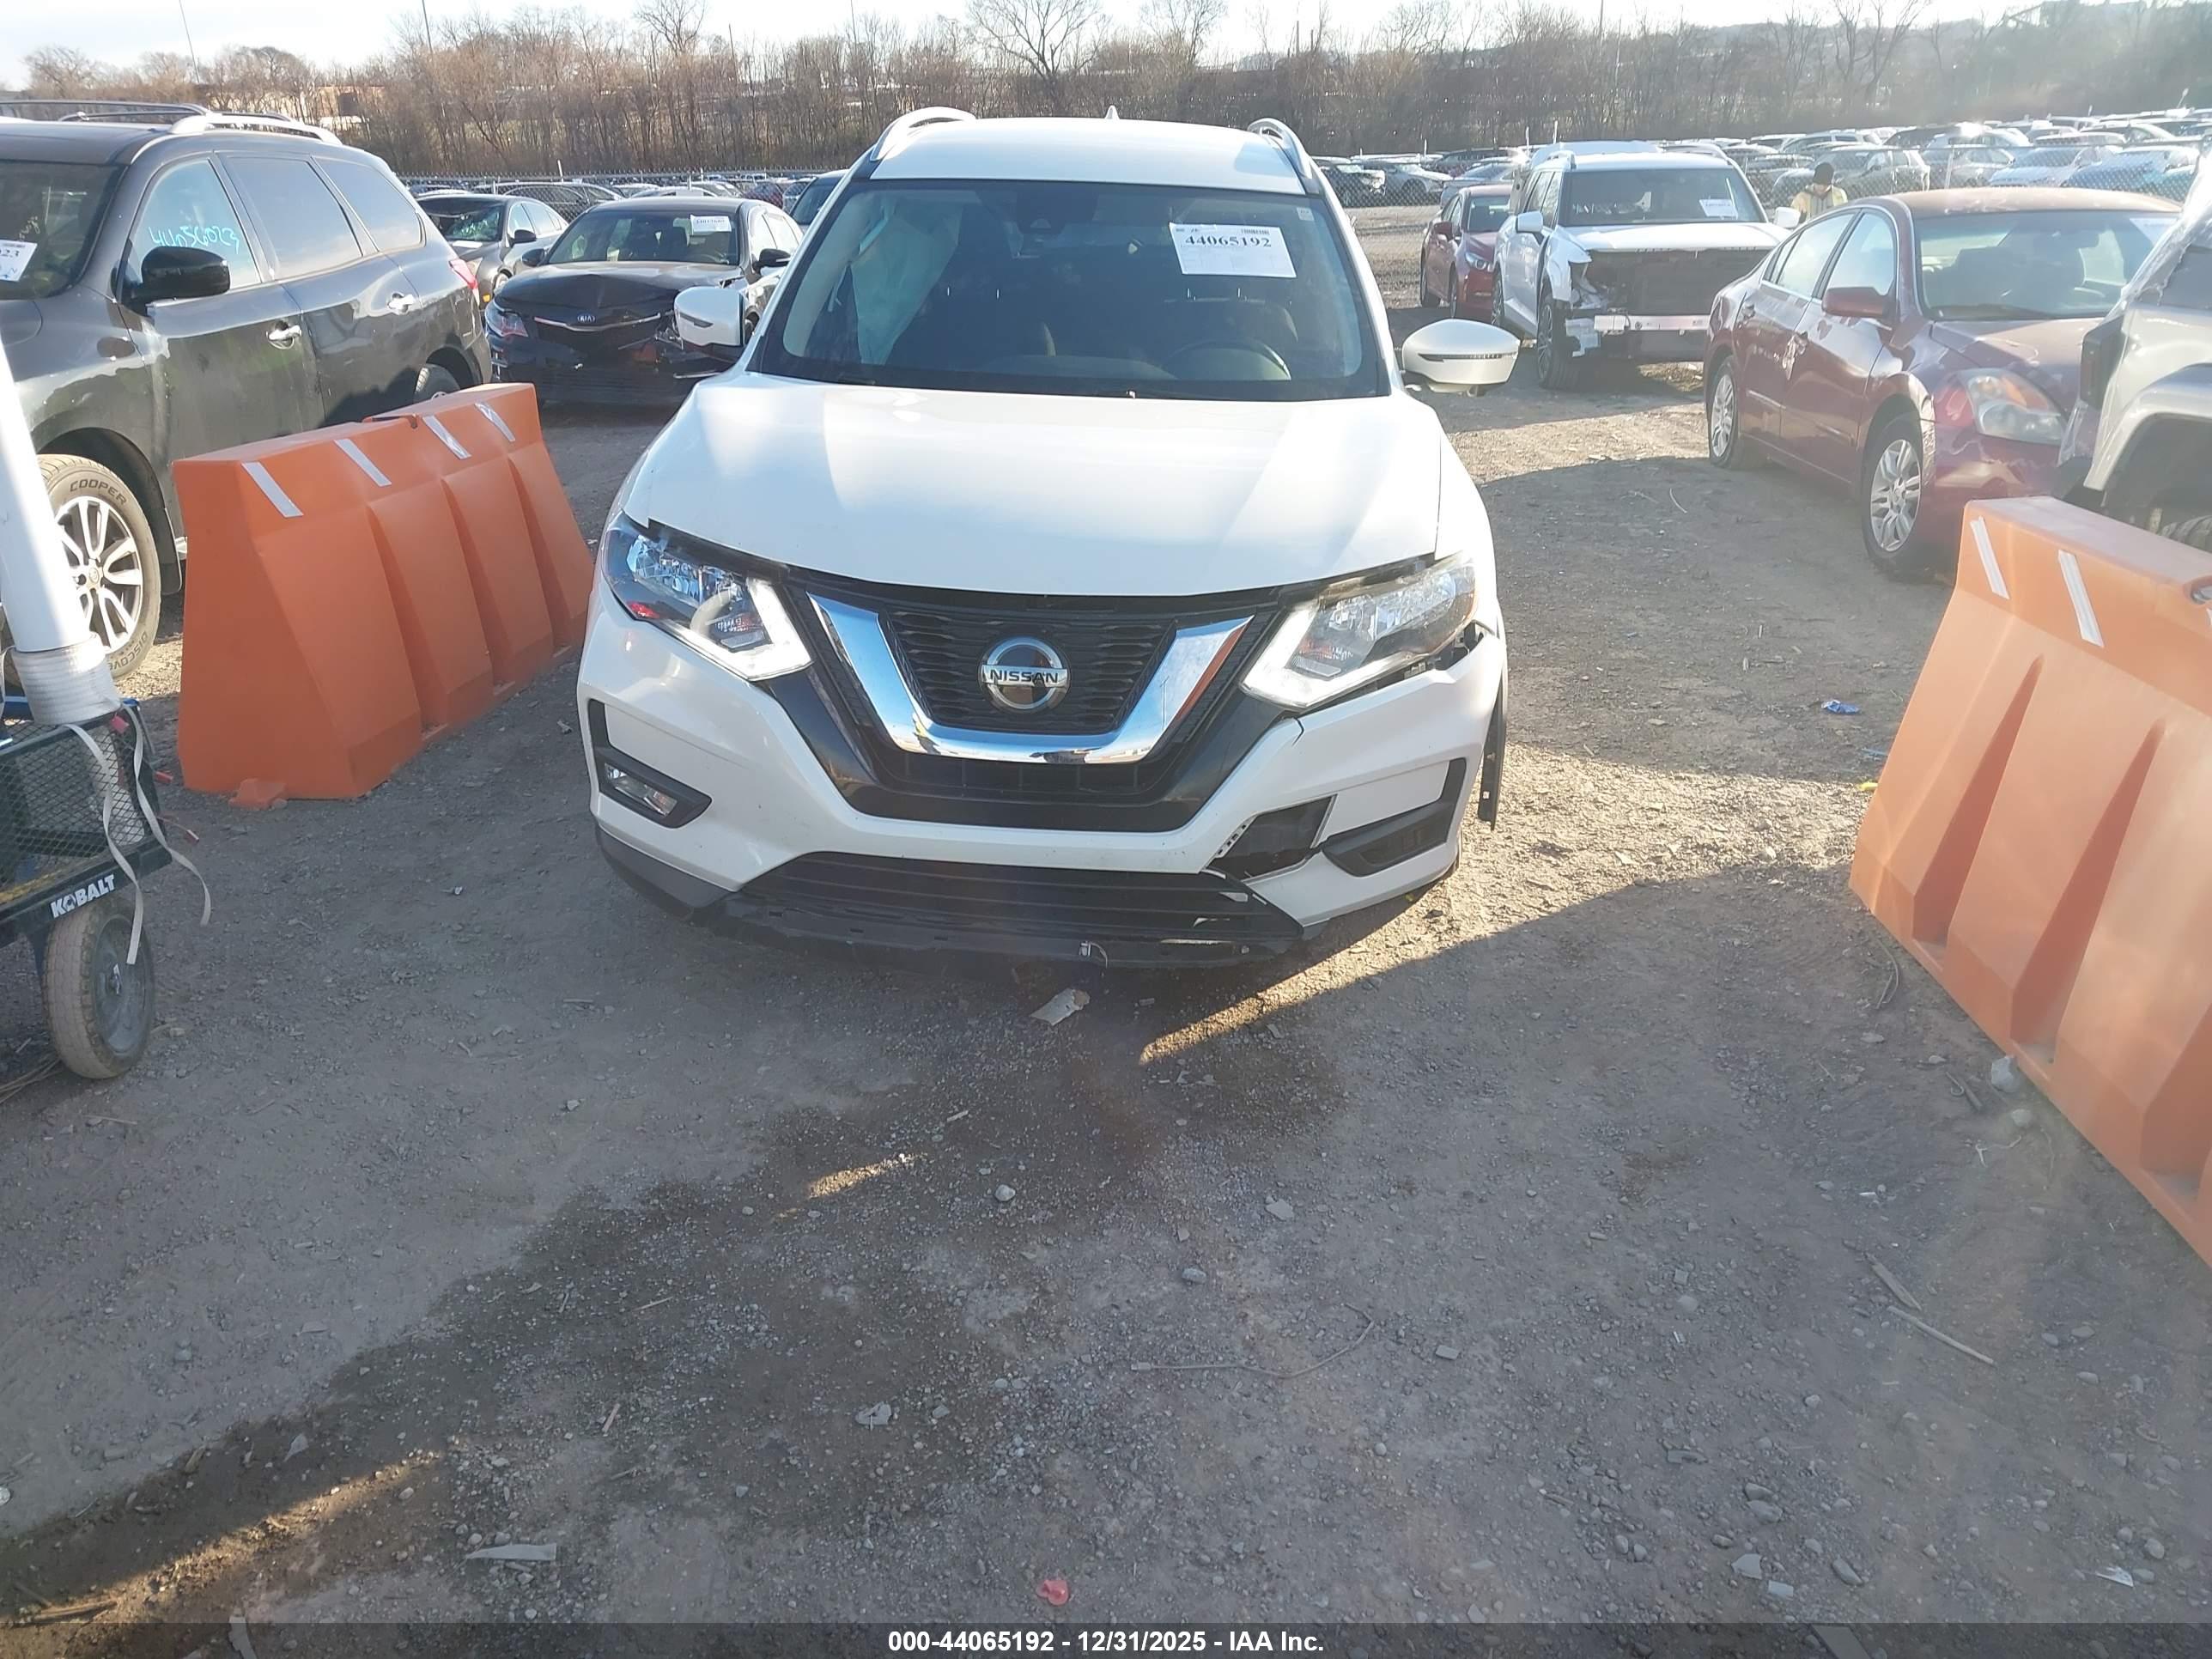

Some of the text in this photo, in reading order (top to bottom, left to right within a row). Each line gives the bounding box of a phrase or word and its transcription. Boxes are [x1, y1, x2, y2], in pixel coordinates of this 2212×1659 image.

[1185, 235, 1272, 247] 44065192
[70, 478, 127, 505] COOPER
[990, 669, 1059, 685] NISSAN
[50, 873, 116, 919] KOBALT
